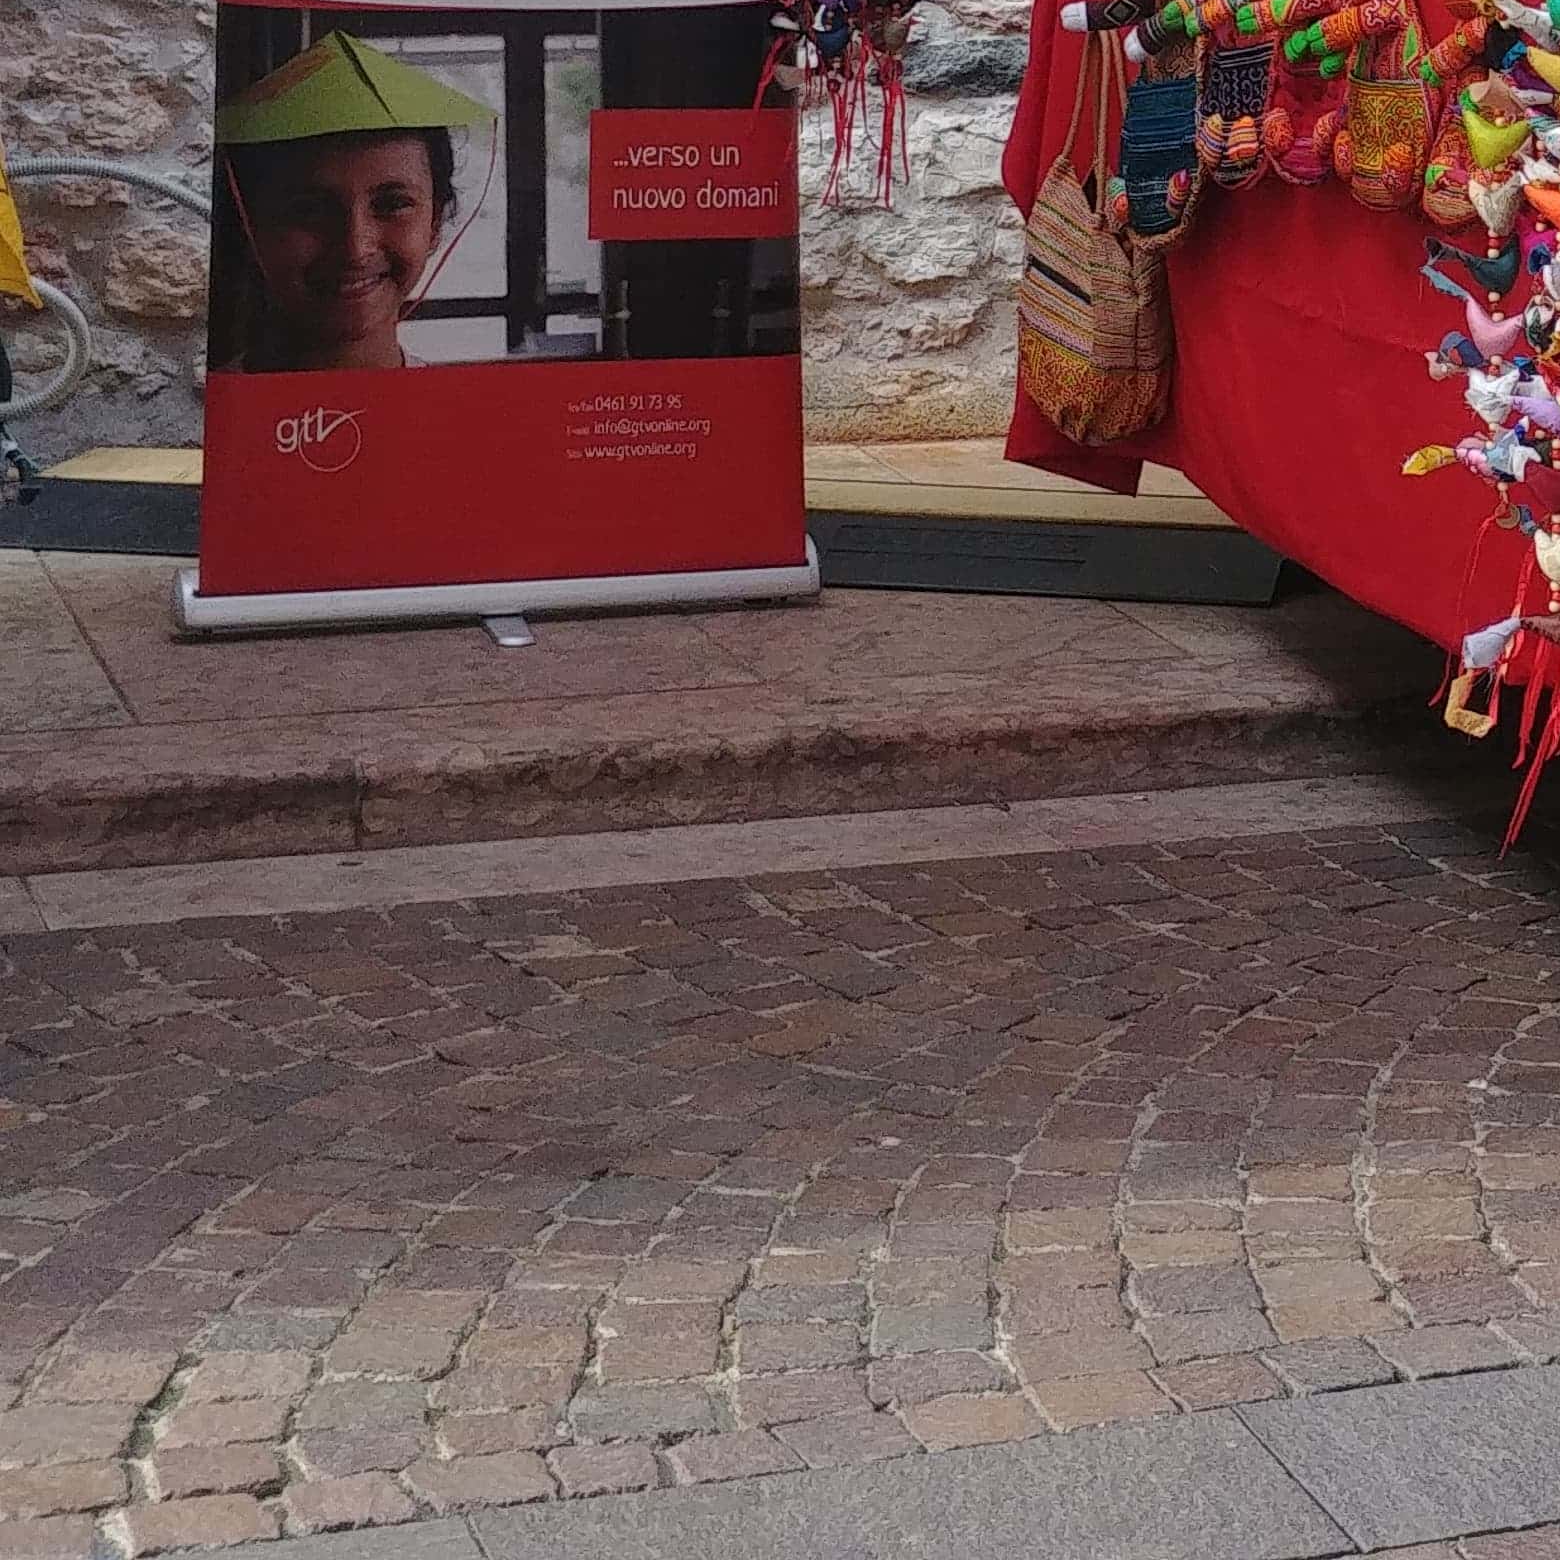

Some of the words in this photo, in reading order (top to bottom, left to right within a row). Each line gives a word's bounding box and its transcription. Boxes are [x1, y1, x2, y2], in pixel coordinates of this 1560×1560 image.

[613, 145, 700, 168] ...verso
[709, 146, 740, 168] un
[613, 186, 686, 211] nuovo
[696, 184, 780, 209] domani
[594, 395, 625, 412] 0461
[629, 394, 645, 410] 91
[649, 394, 662, 410] 73
[666, 394, 683, 409] 95
[594, 417, 711, 438] info@gtvonline.org
[584, 442, 697, 462] www.gtvonline.org
